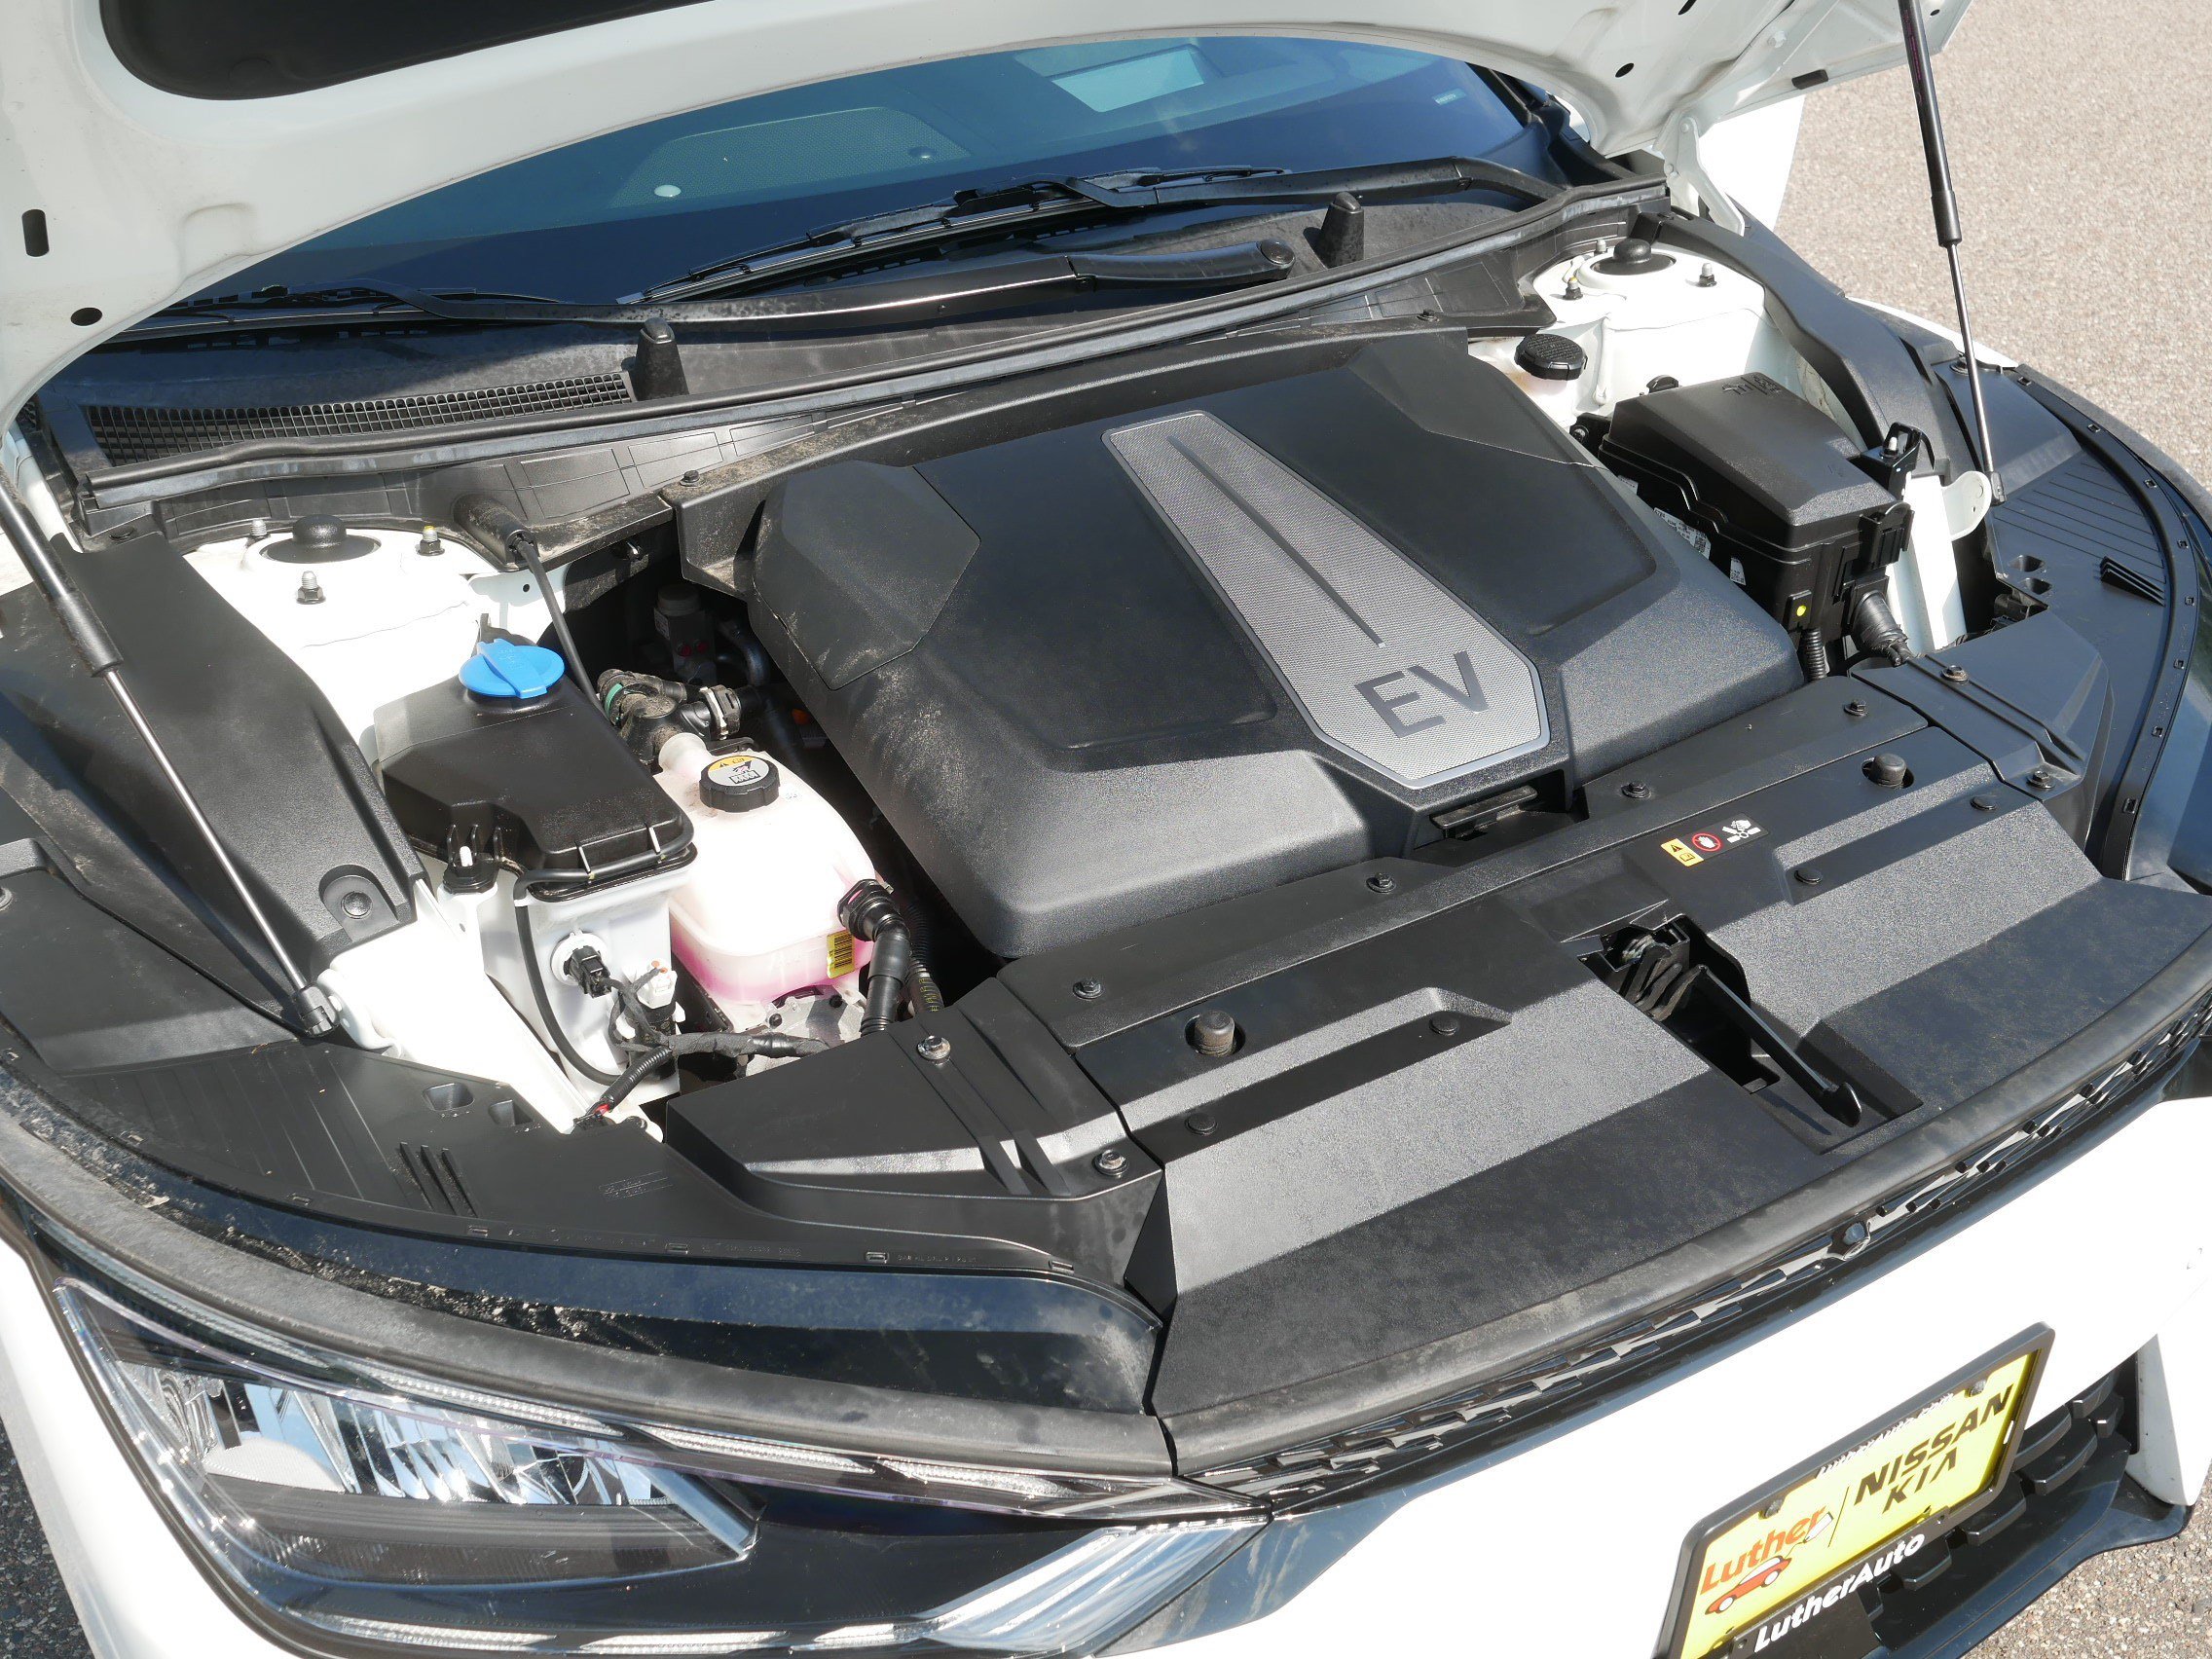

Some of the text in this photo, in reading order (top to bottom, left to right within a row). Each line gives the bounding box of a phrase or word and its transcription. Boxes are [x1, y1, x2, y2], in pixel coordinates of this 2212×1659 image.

[1354, 650, 1490, 739] EV
[1854, 1383, 2013, 1506] NISSAN
[1882, 1447, 1957, 1515] KIA
[1700, 1506, 1826, 1595] Luther
[1754, 1533, 1925, 1653] LutherAuto
